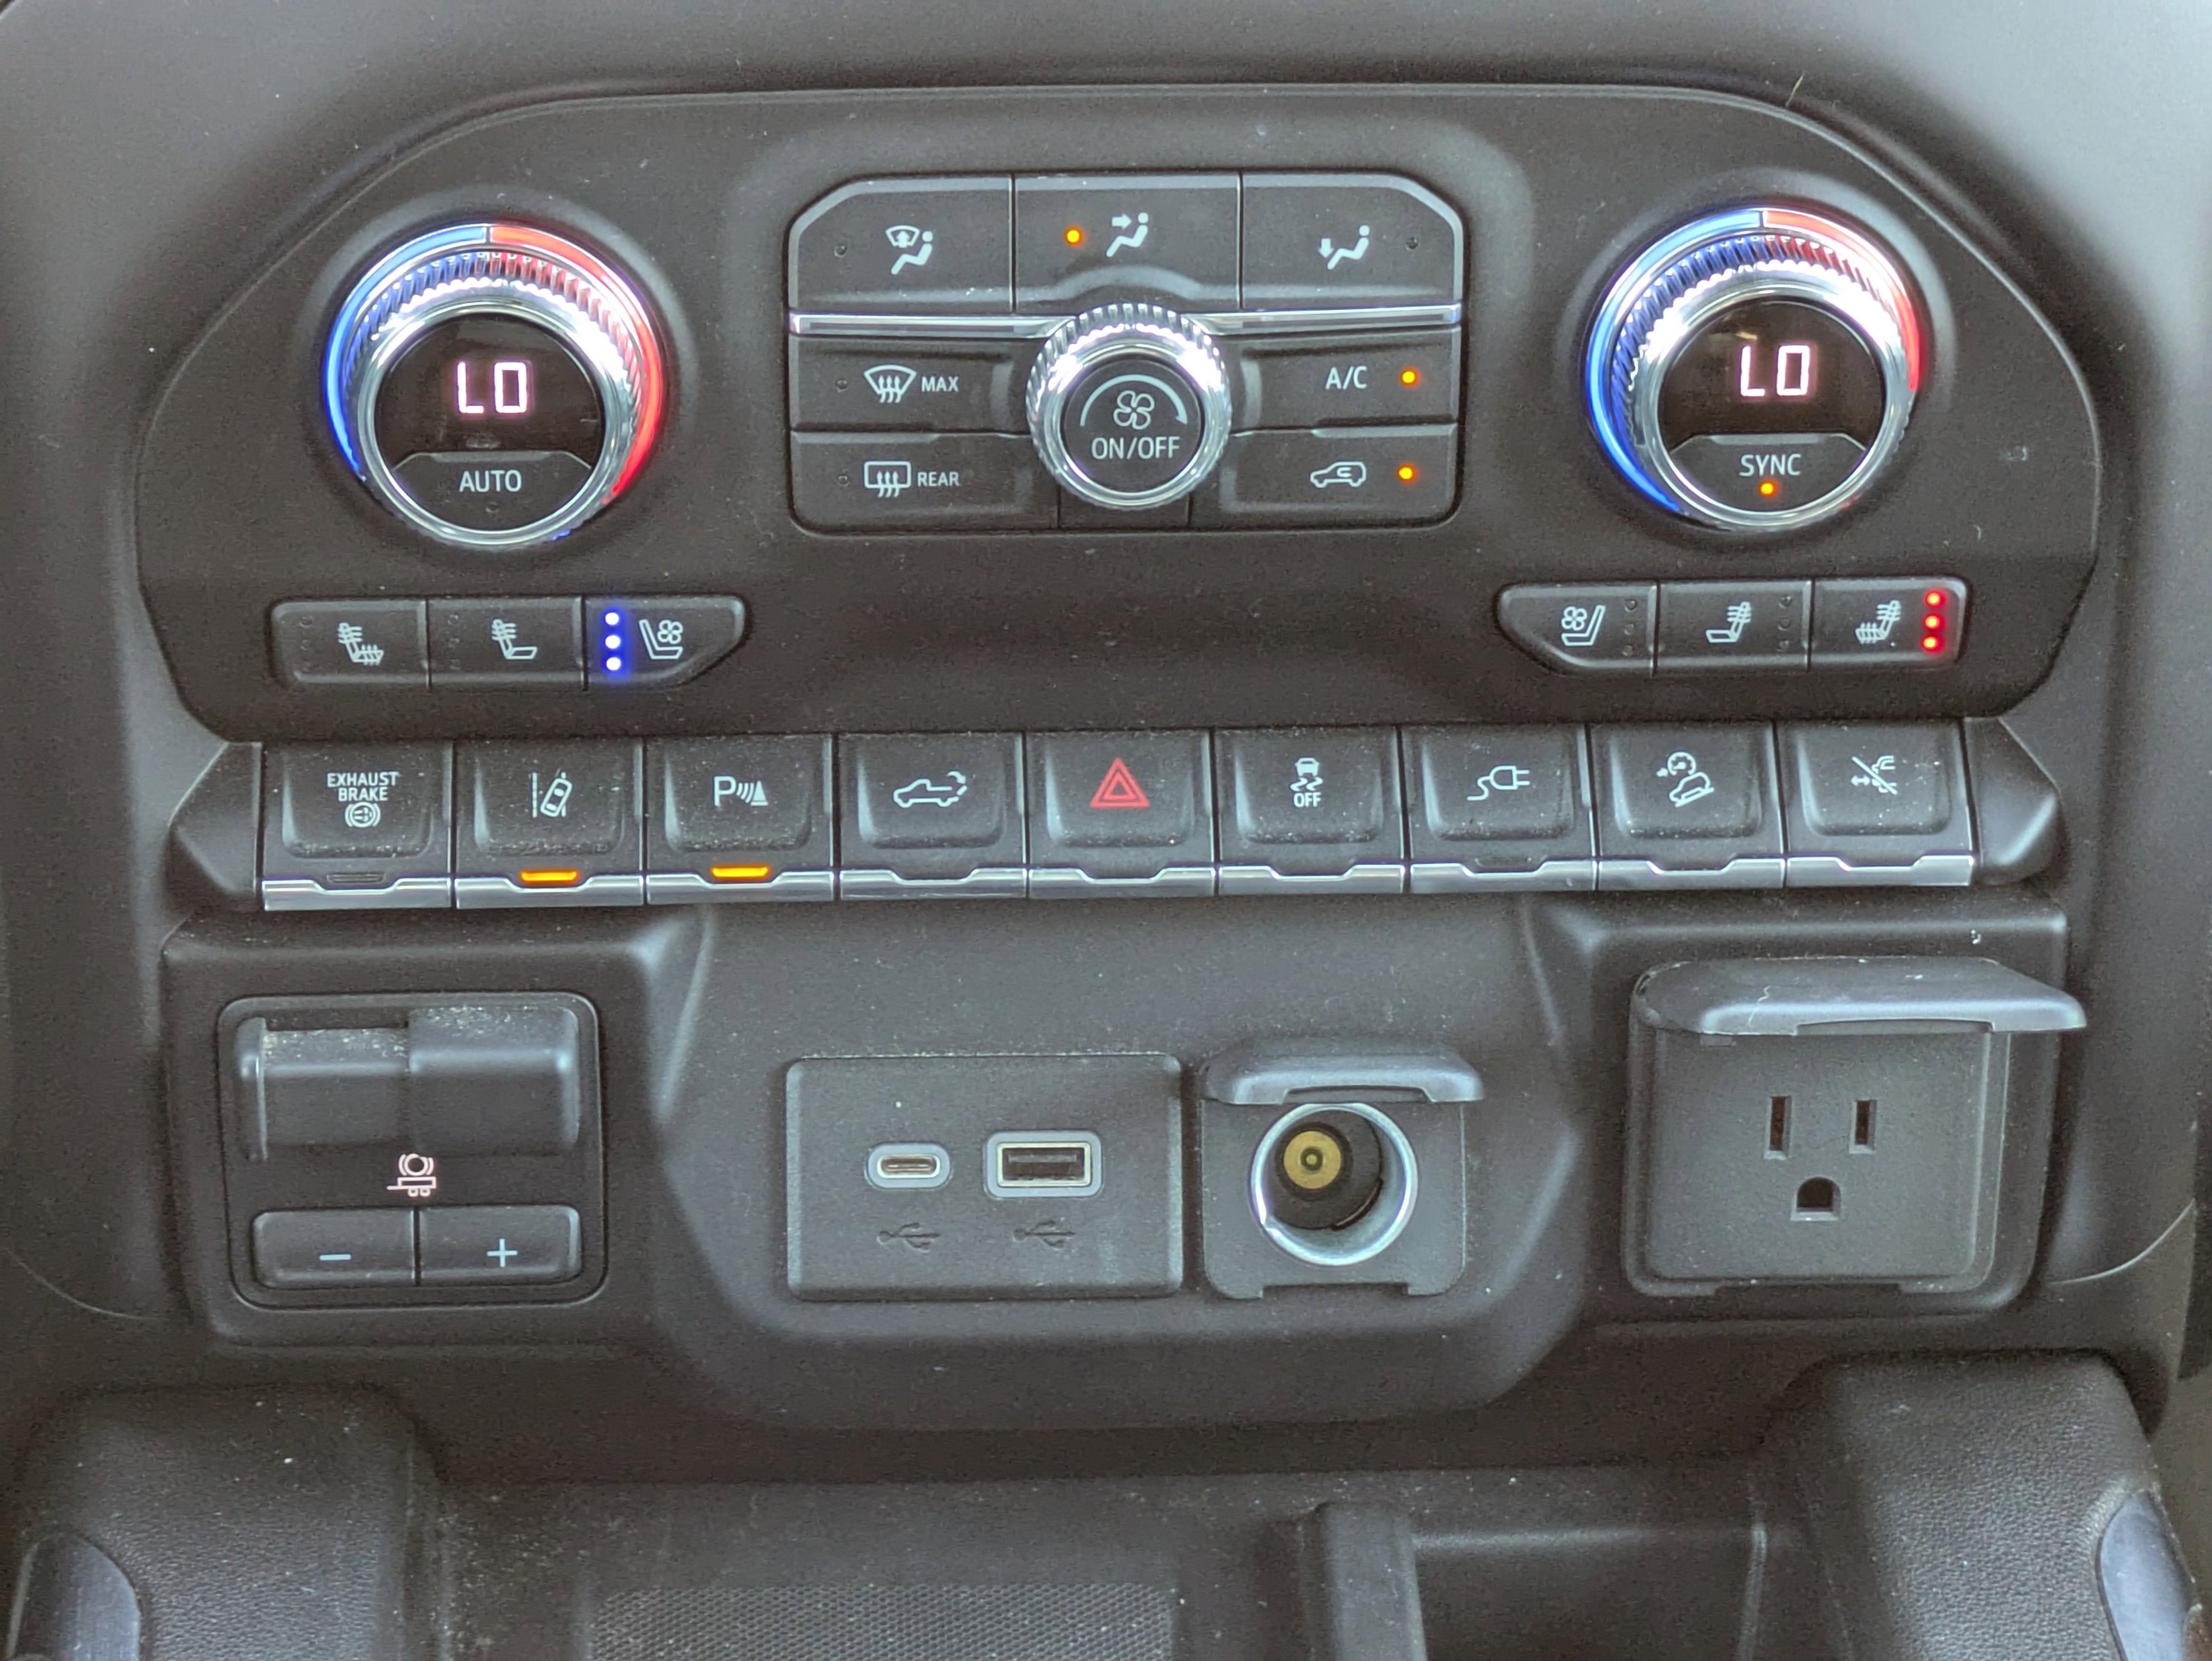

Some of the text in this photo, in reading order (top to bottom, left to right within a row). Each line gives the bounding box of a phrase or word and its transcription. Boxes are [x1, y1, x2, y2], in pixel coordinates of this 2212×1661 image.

[1326, 366, 1367, 390] A/C
[1740, 345, 1810, 397] LO
[457, 362, 527, 414] LO
[921, 376, 959, 392] MAX
[1091, 436, 1181, 460] ON/OFF
[1739, 454, 1802, 477] SYNC
[459, 470, 522, 492] AUTO
[917, 472, 960, 487] REAR
[327, 771, 399, 787] EXHAUST
[338, 786, 388, 802] BRAKE
[714, 775, 737, 806] P
[1293, 792, 1322, 808] OFF
